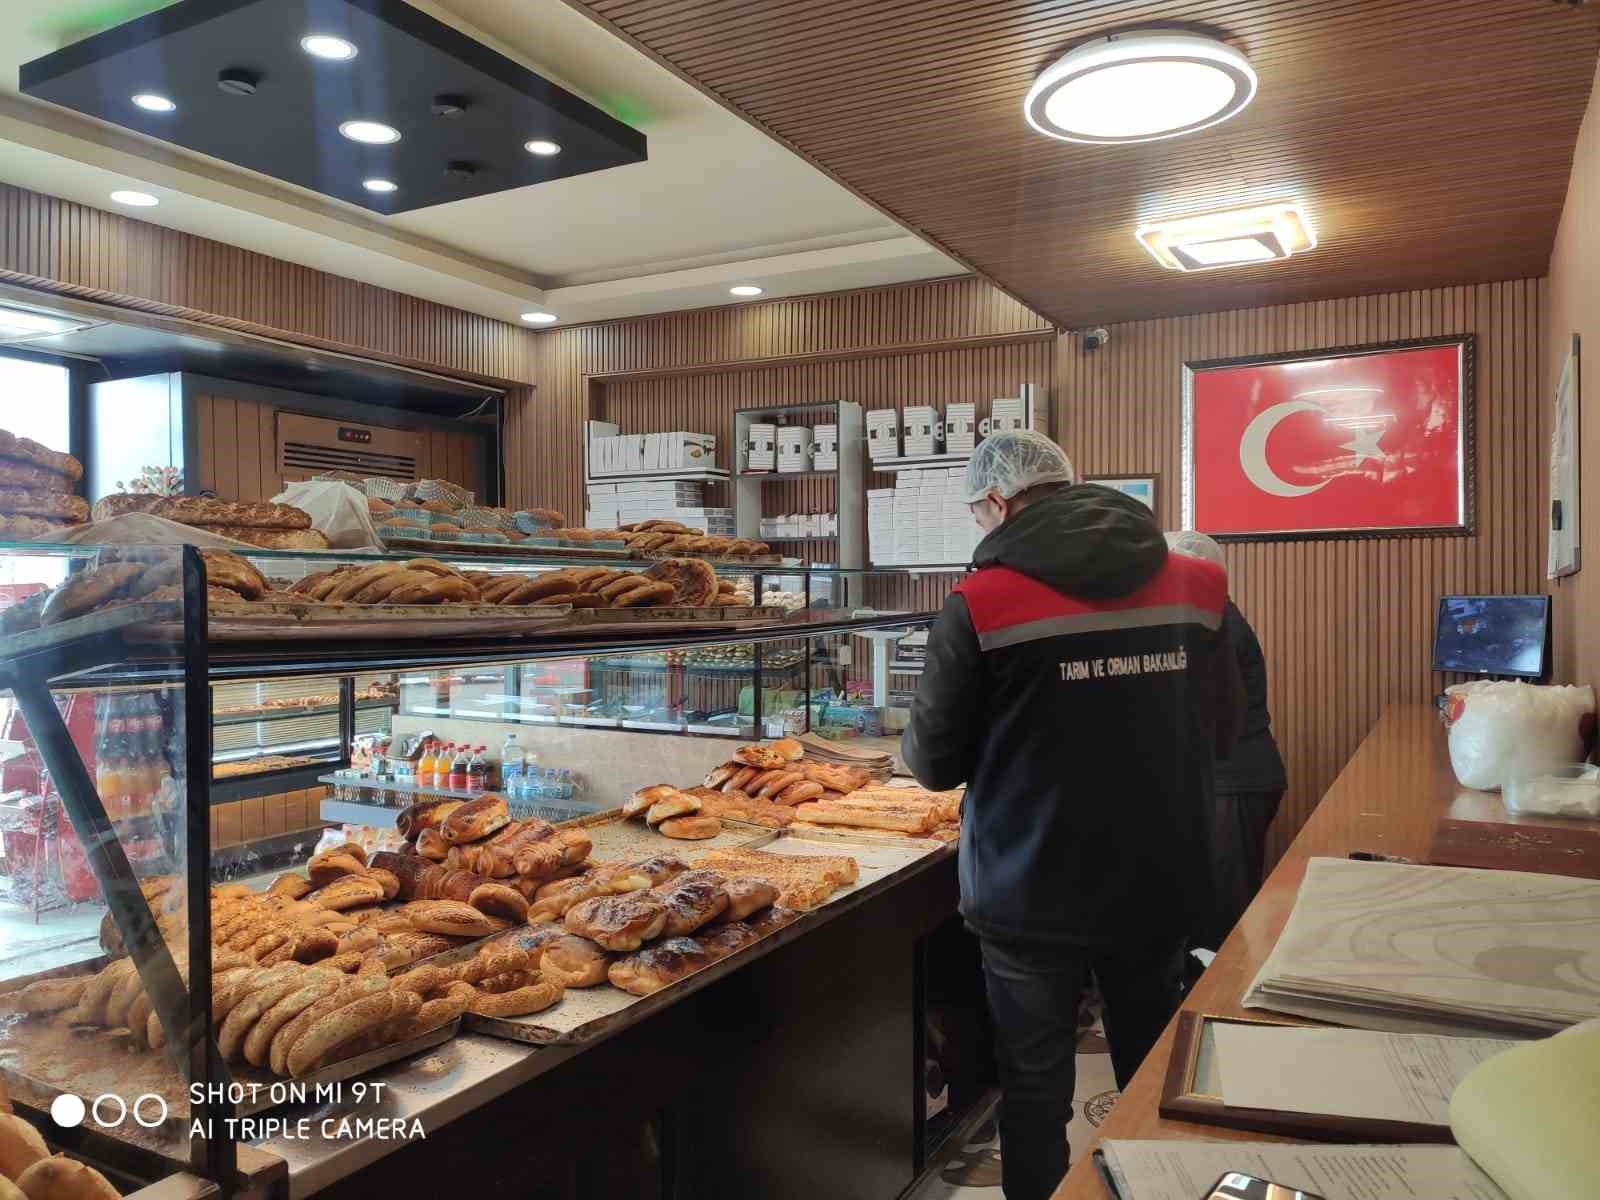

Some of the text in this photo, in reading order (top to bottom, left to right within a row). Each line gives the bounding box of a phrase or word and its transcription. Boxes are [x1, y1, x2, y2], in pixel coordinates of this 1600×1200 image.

[1059, 661, 1090, 680] TARIM
[1092, 659, 1105, 678] VE
[1107, 655, 1141, 676] ORMAN
